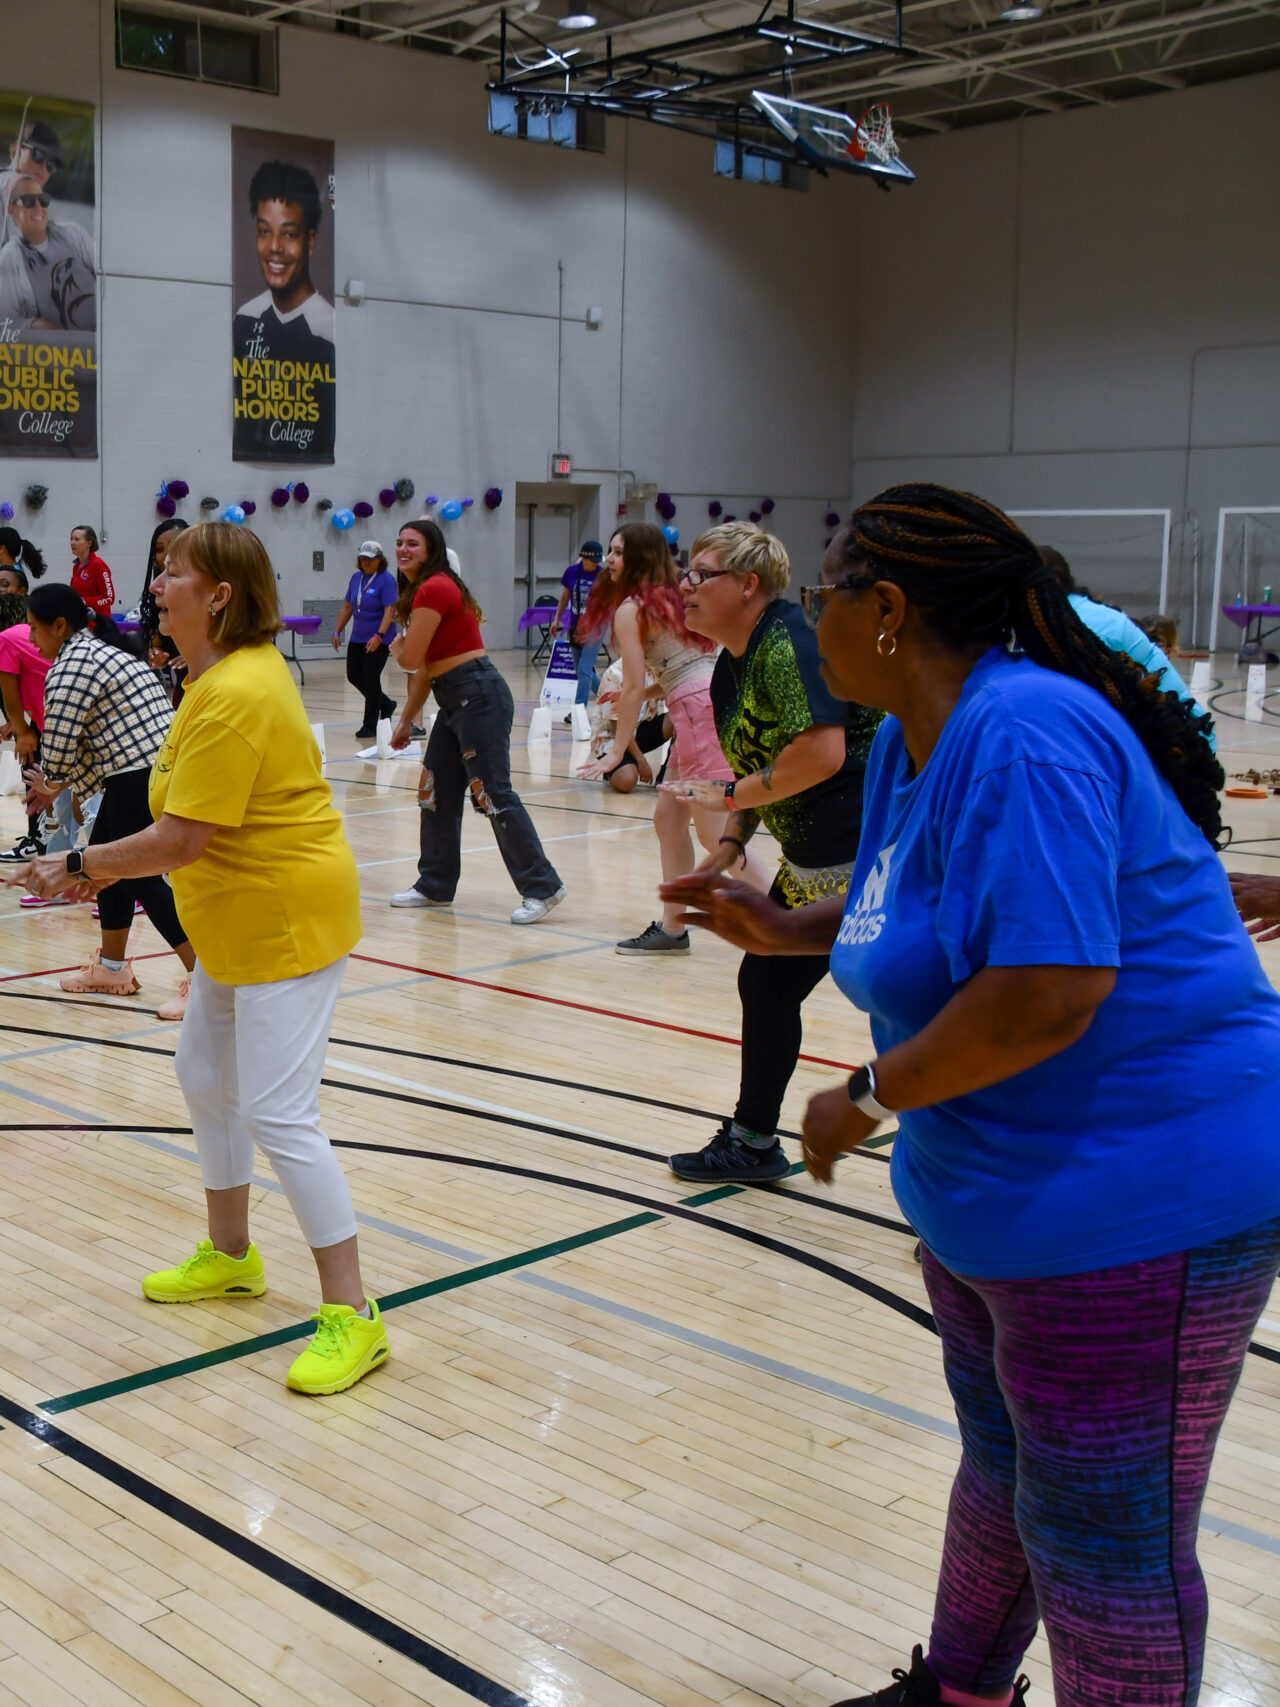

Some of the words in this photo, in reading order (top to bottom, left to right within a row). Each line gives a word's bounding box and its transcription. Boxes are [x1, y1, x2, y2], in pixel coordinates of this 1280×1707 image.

[246, 336, 269, 359] The
[233, 358, 336, 383] NATIONAL
[242, 379, 315, 401] PUBLIC
[234, 399, 320, 422] HONORS
[19, 411, 74, 442] College
[270, 420, 314, 449] College
